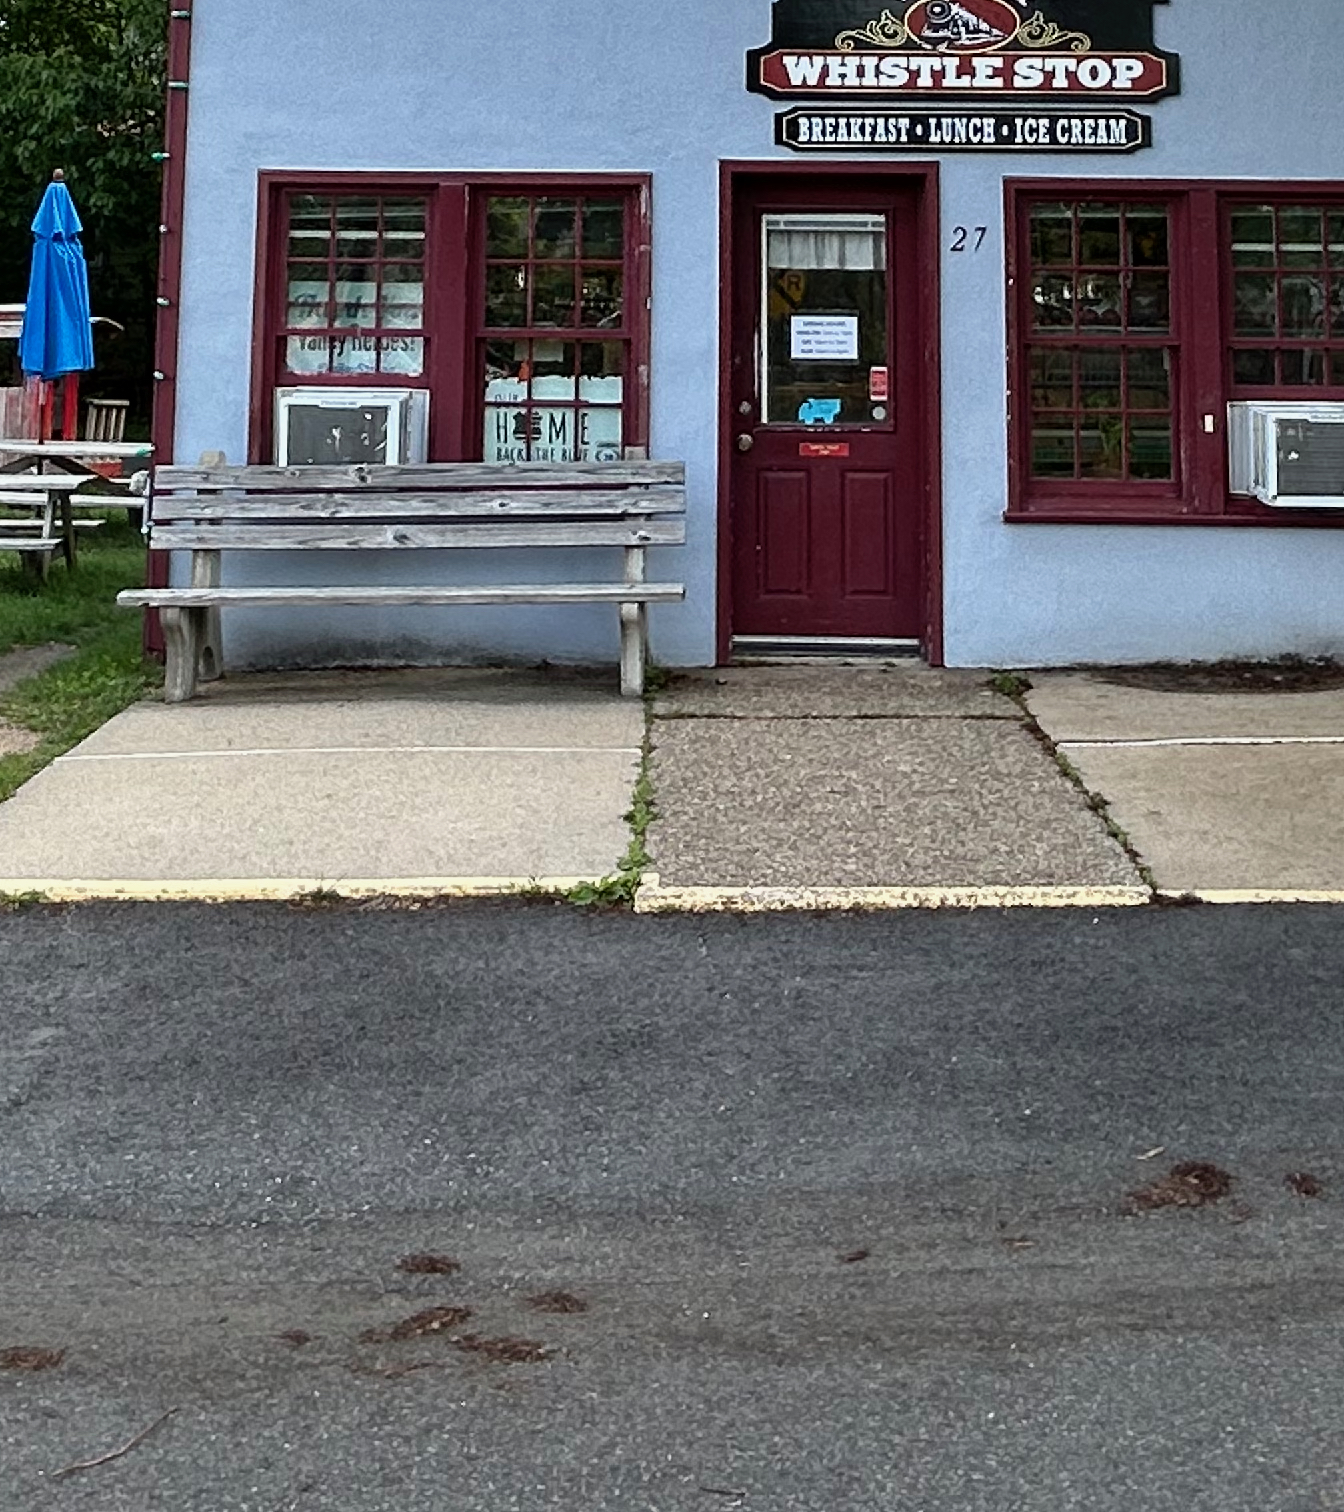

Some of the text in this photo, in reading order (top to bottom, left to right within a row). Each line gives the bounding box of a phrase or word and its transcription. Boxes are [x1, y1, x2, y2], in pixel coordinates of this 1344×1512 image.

[782, 55, 1146, 90] WHISTLE STOP
[798, 117, 1128, 145] BREAKFAST LUNCH ICE CREAM
[950, 225, 988, 253] 27
[298, 336, 346, 357] Vally
